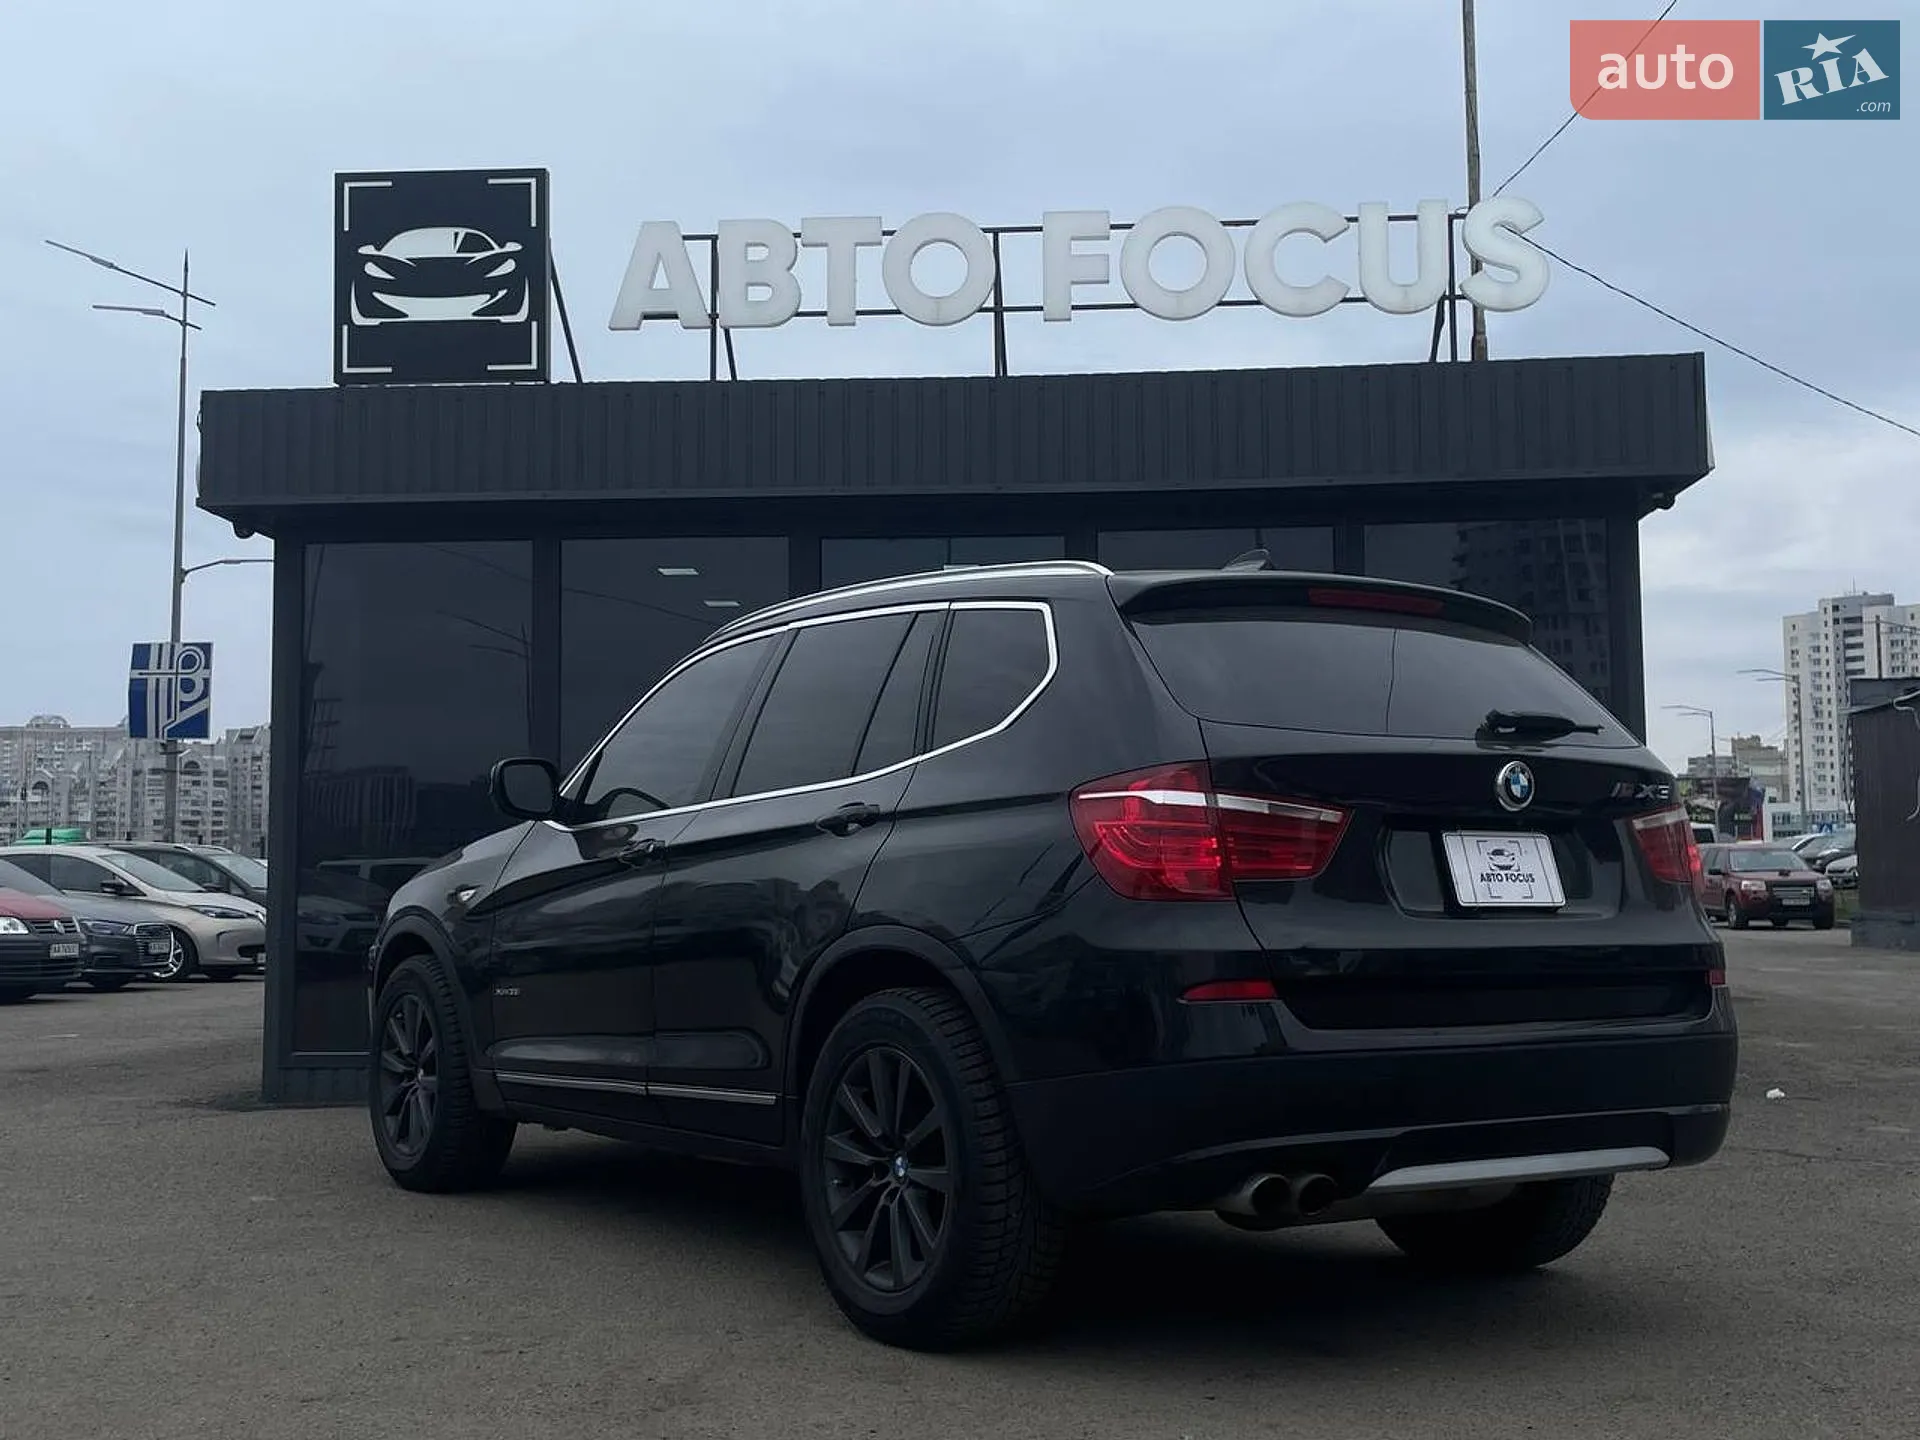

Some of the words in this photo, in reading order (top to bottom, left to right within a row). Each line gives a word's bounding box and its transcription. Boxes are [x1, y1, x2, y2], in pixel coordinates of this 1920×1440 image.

[609, 212, 996, 330] АВТО
[1043, 197, 1550, 322] FOCUS
[1504, 872, 1535, 883] FOCUS
